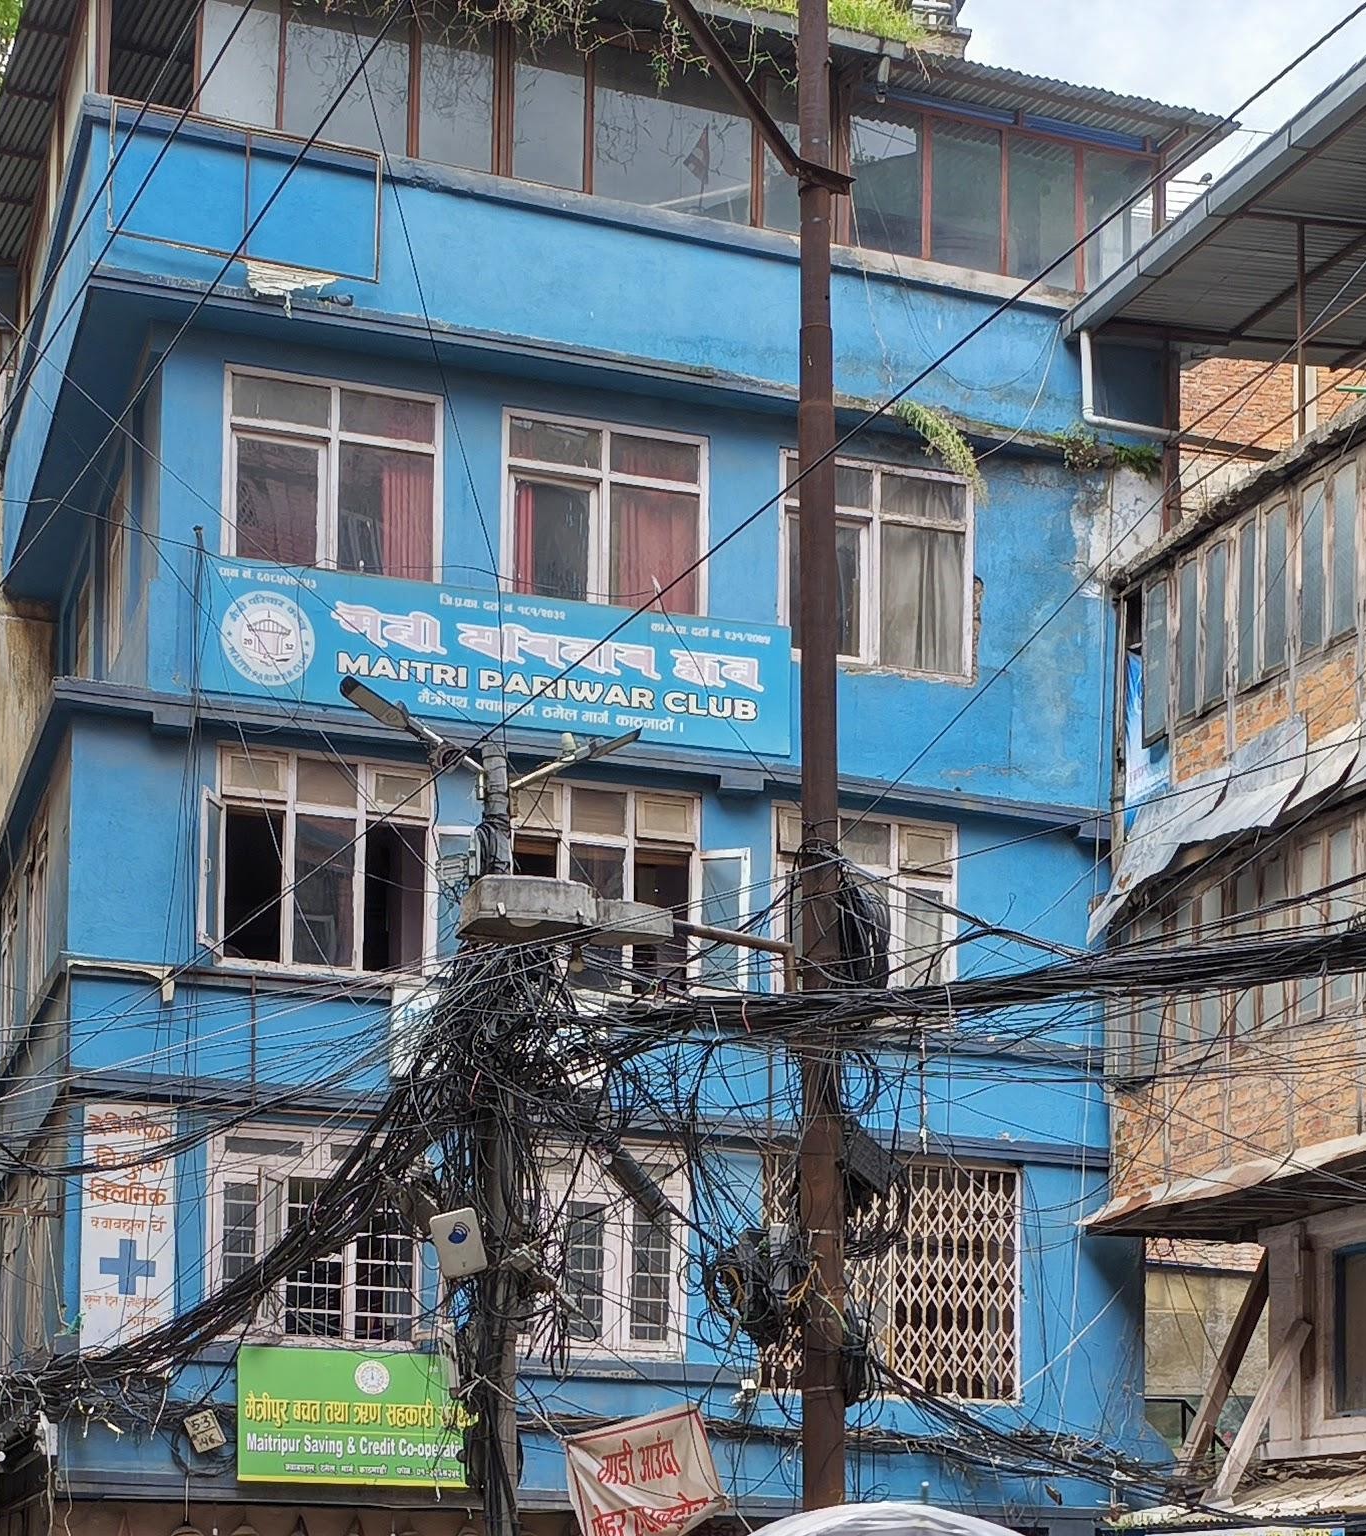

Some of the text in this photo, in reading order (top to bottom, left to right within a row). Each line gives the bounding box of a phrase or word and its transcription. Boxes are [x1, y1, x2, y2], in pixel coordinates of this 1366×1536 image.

[337, 652, 758, 721] MAITRI PARIWAR CLUB
[244, 1391, 289, 1428] मैत्रीपुर
[293, 1399, 322, 1424] बचत
[324, 1400, 350, 1424] तथा
[353, 1401, 383, 1426] ऋण
[385, 1398, 436, 1428] सहकारी
[246, 1432, 301, 1457] Maitripur
[304, 1435, 344, 1458] Saving
[347, 1436, 357, 1453] &
[359, 1436, 396, 1457] Credit
[597, 1438, 636, 1486] गाडी
